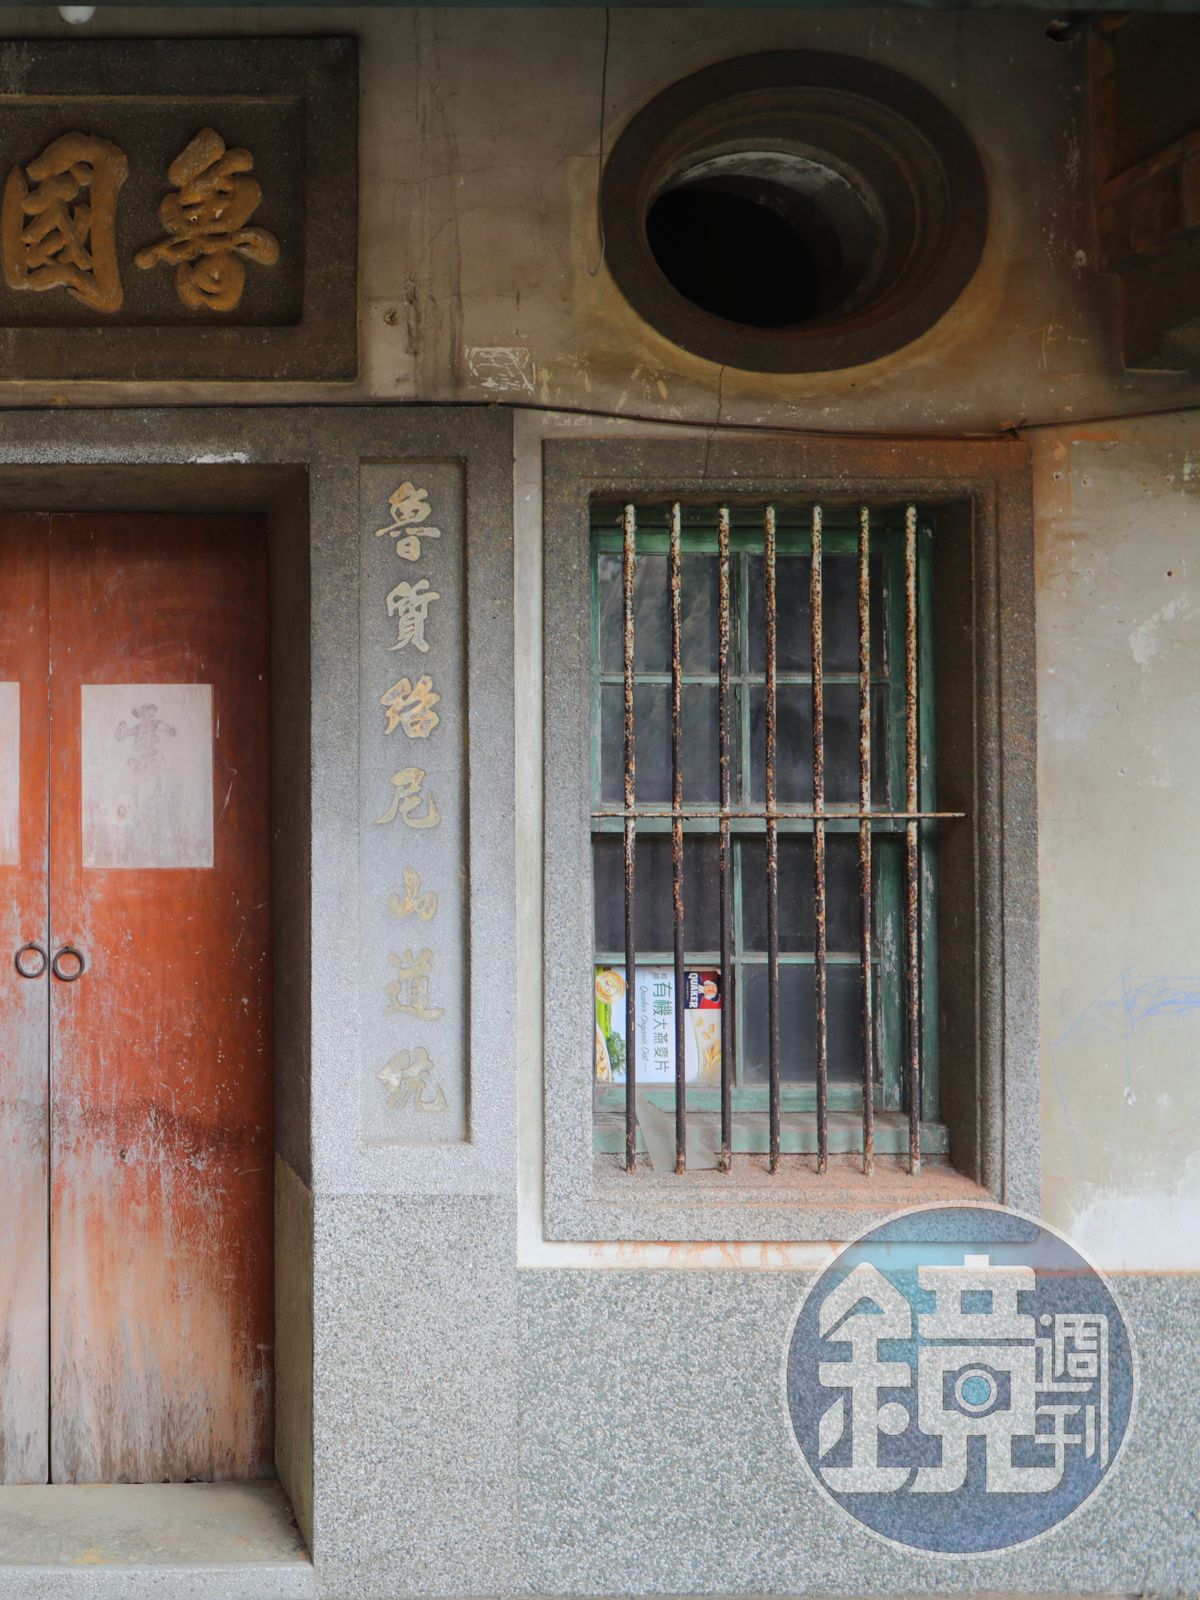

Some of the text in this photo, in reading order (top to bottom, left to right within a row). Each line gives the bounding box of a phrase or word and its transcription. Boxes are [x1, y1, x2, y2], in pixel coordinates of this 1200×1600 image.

[688, 973, 699, 1009] QUAKER
[653, 982, 673, 1073] 有機大燕麥片
